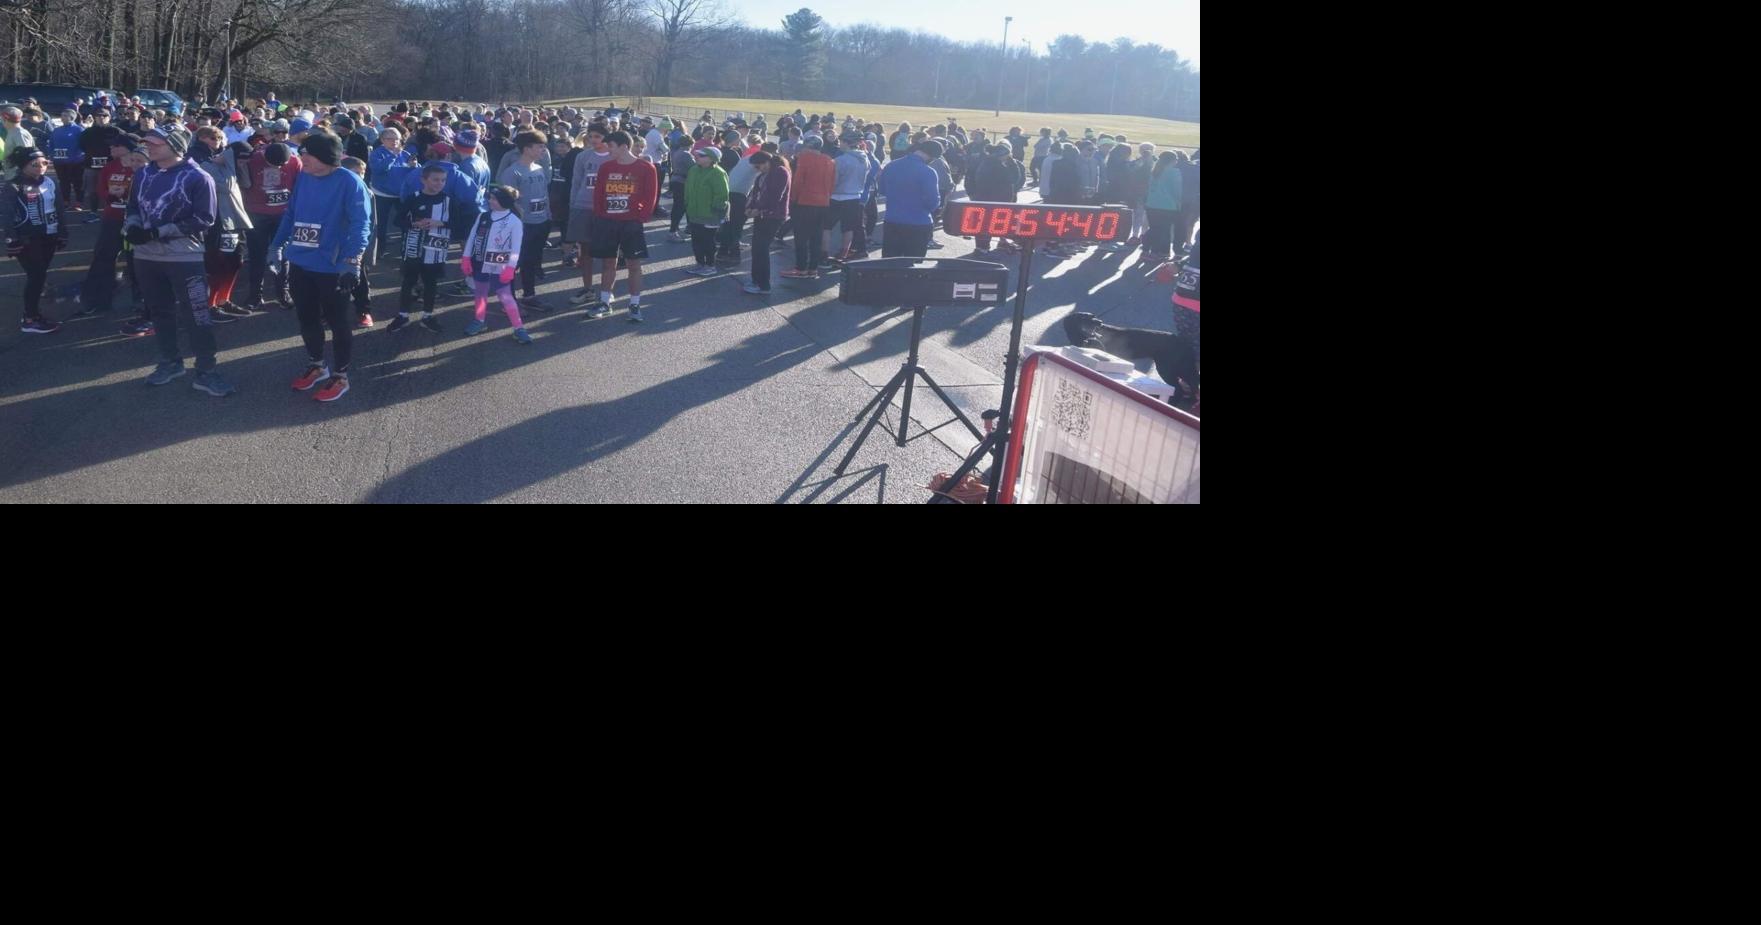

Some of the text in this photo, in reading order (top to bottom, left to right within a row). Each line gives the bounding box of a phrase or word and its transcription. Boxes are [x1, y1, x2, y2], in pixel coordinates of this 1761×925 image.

[605, 183, 635, 193] DASH
[607, 200, 628, 210] 229
[960, 206, 1120, 240] 08:54:40
[294, 227, 318, 242] 482
